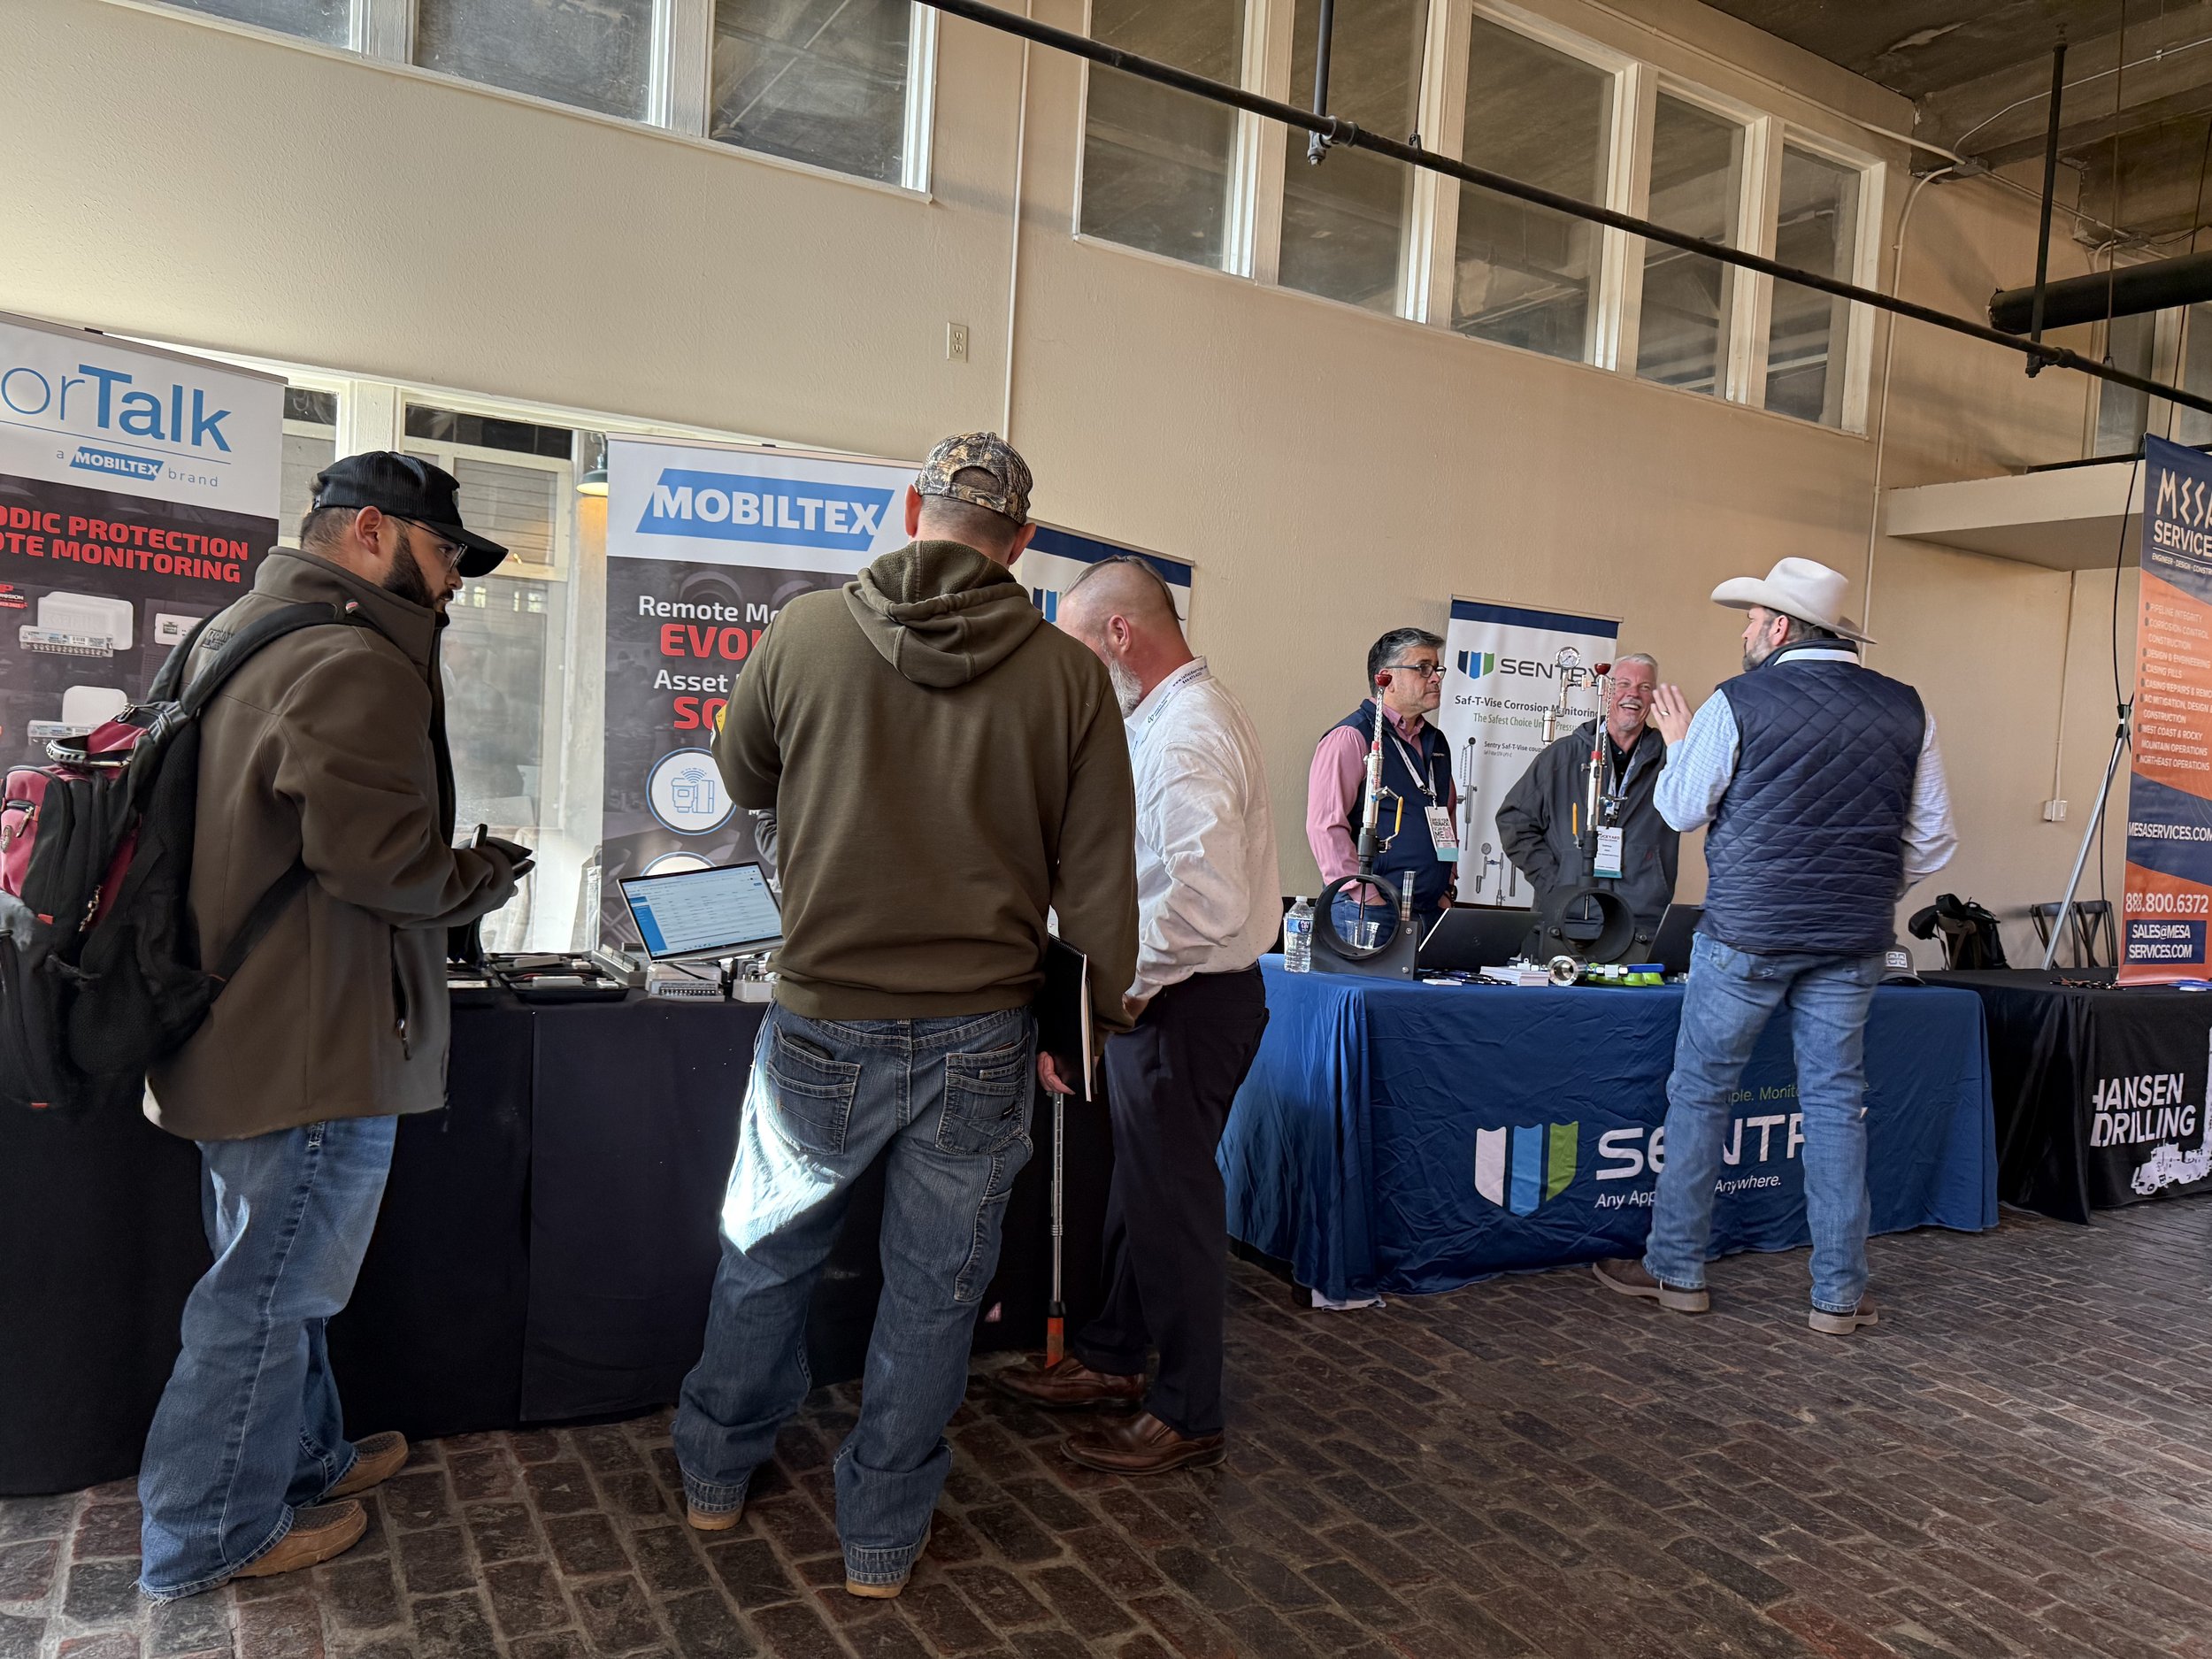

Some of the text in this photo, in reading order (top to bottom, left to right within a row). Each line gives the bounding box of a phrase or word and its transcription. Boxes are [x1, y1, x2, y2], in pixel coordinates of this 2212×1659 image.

[56, 449, 219, 487] a MOBILTEX brand
[653, 485, 879, 535] MOBILTEX
[68, 516, 248, 561] PROTECTION
[0, 533, 241, 583] TE MONITORING
[2151, 552, 2173, 565] ENGINEER
[2175, 559, 2192, 571] DESIGN
[639, 595, 739, 622] Remote
[2150, 603, 2174, 617] PIPELINE
[2149, 618, 2208, 640] CORROSION CONTROL
[2147, 633, 2192, 650] CONSTRUCTION
[2147, 649, 2168, 661] DESIGN
[2173, 654, 2210, 669] ENGINEERING
[2145, 664, 2182, 679] CASING FILLS
[653, 669, 728, 693] Asset
[2145, 679, 2166, 691] CASING
[2166, 682, 2190, 695] REPAIRS
[1455, 695, 1502, 710] Saf-T-Vise
[1503, 699, 1548, 714] Corrosion
[2144, 694, 2153, 703] AC
[2187, 701, 2209, 712] DESIGN
[1473, 712, 1487, 724] The
[1488, 714, 1509, 726] Safest
[1509, 718, 1533, 729] Choice
[2143, 709, 2186, 724] CONSTRUCTION
[2141, 724, 2156, 735] WEST
[2157, 726, 2177, 738] COAST
[2182, 730, 2203, 741] ROCKY
[1484, 741, 1502, 750] Sentry
[1502, 742, 1528, 752] Saf-T-Vise
[2141, 740, 2208, 757] MOUNTAIN OPERATIONS
[2139, 755, 2210, 772] NORTHEAST OPERATIONS
[2125, 892, 2208, 914] 888.800.6372
[2131, 924, 2191, 940] SALES@MESA
[2129, 944, 2193, 959] SERVICES.COM
[2090, 1105, 2196, 1147] DRILLING
[1594, 1193, 1625, 1210] Any
[1714, 1173, 1782, 1195] Anywhere.
